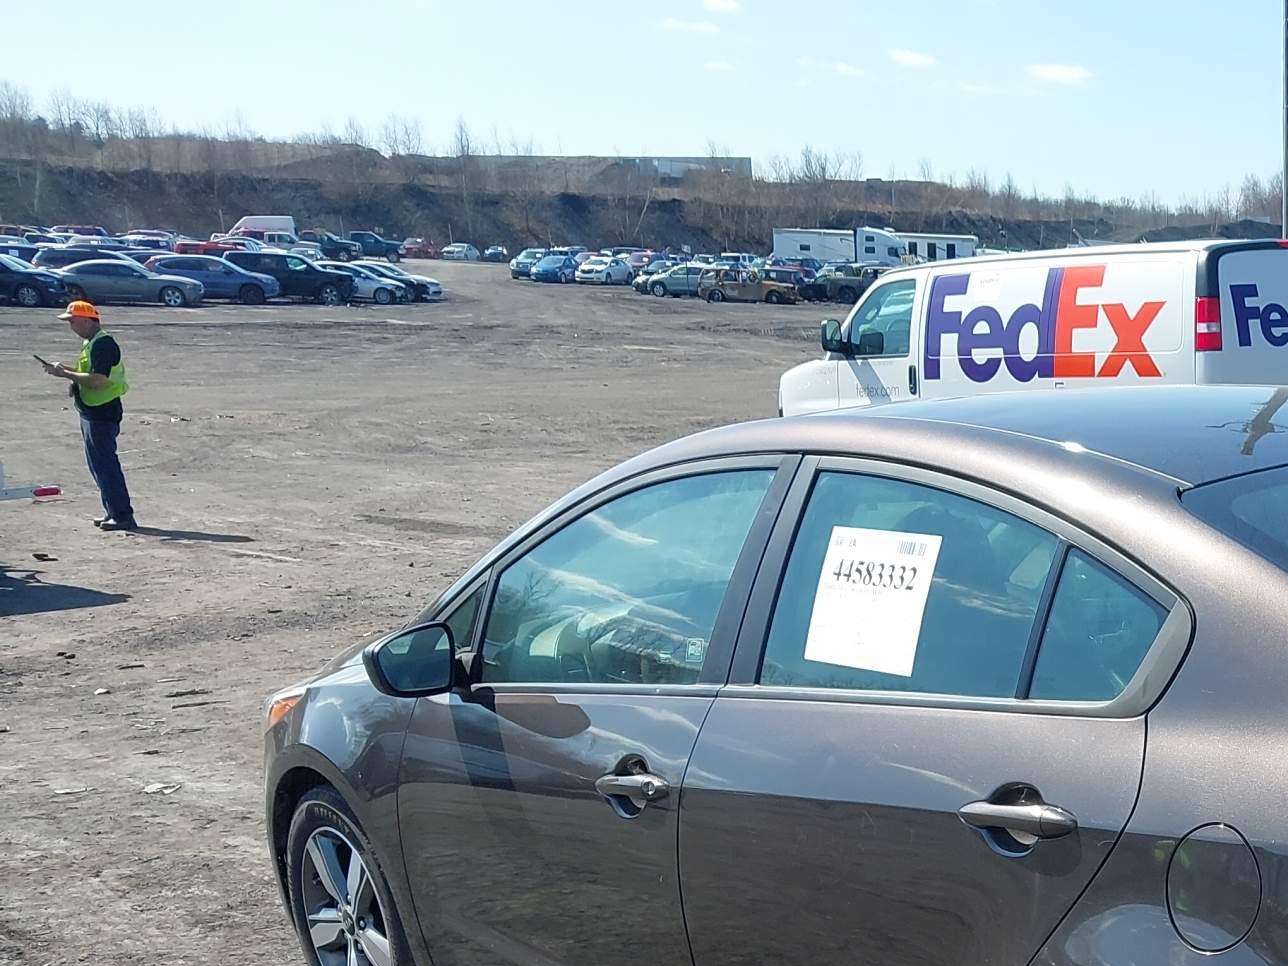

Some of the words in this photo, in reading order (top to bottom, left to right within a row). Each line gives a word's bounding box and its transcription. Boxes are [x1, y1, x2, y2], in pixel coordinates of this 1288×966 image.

[924, 265, 1167, 383] FedEx
[856, 383, 900, 397] fedex.com
[833, 559, 918, 591] 44583332
